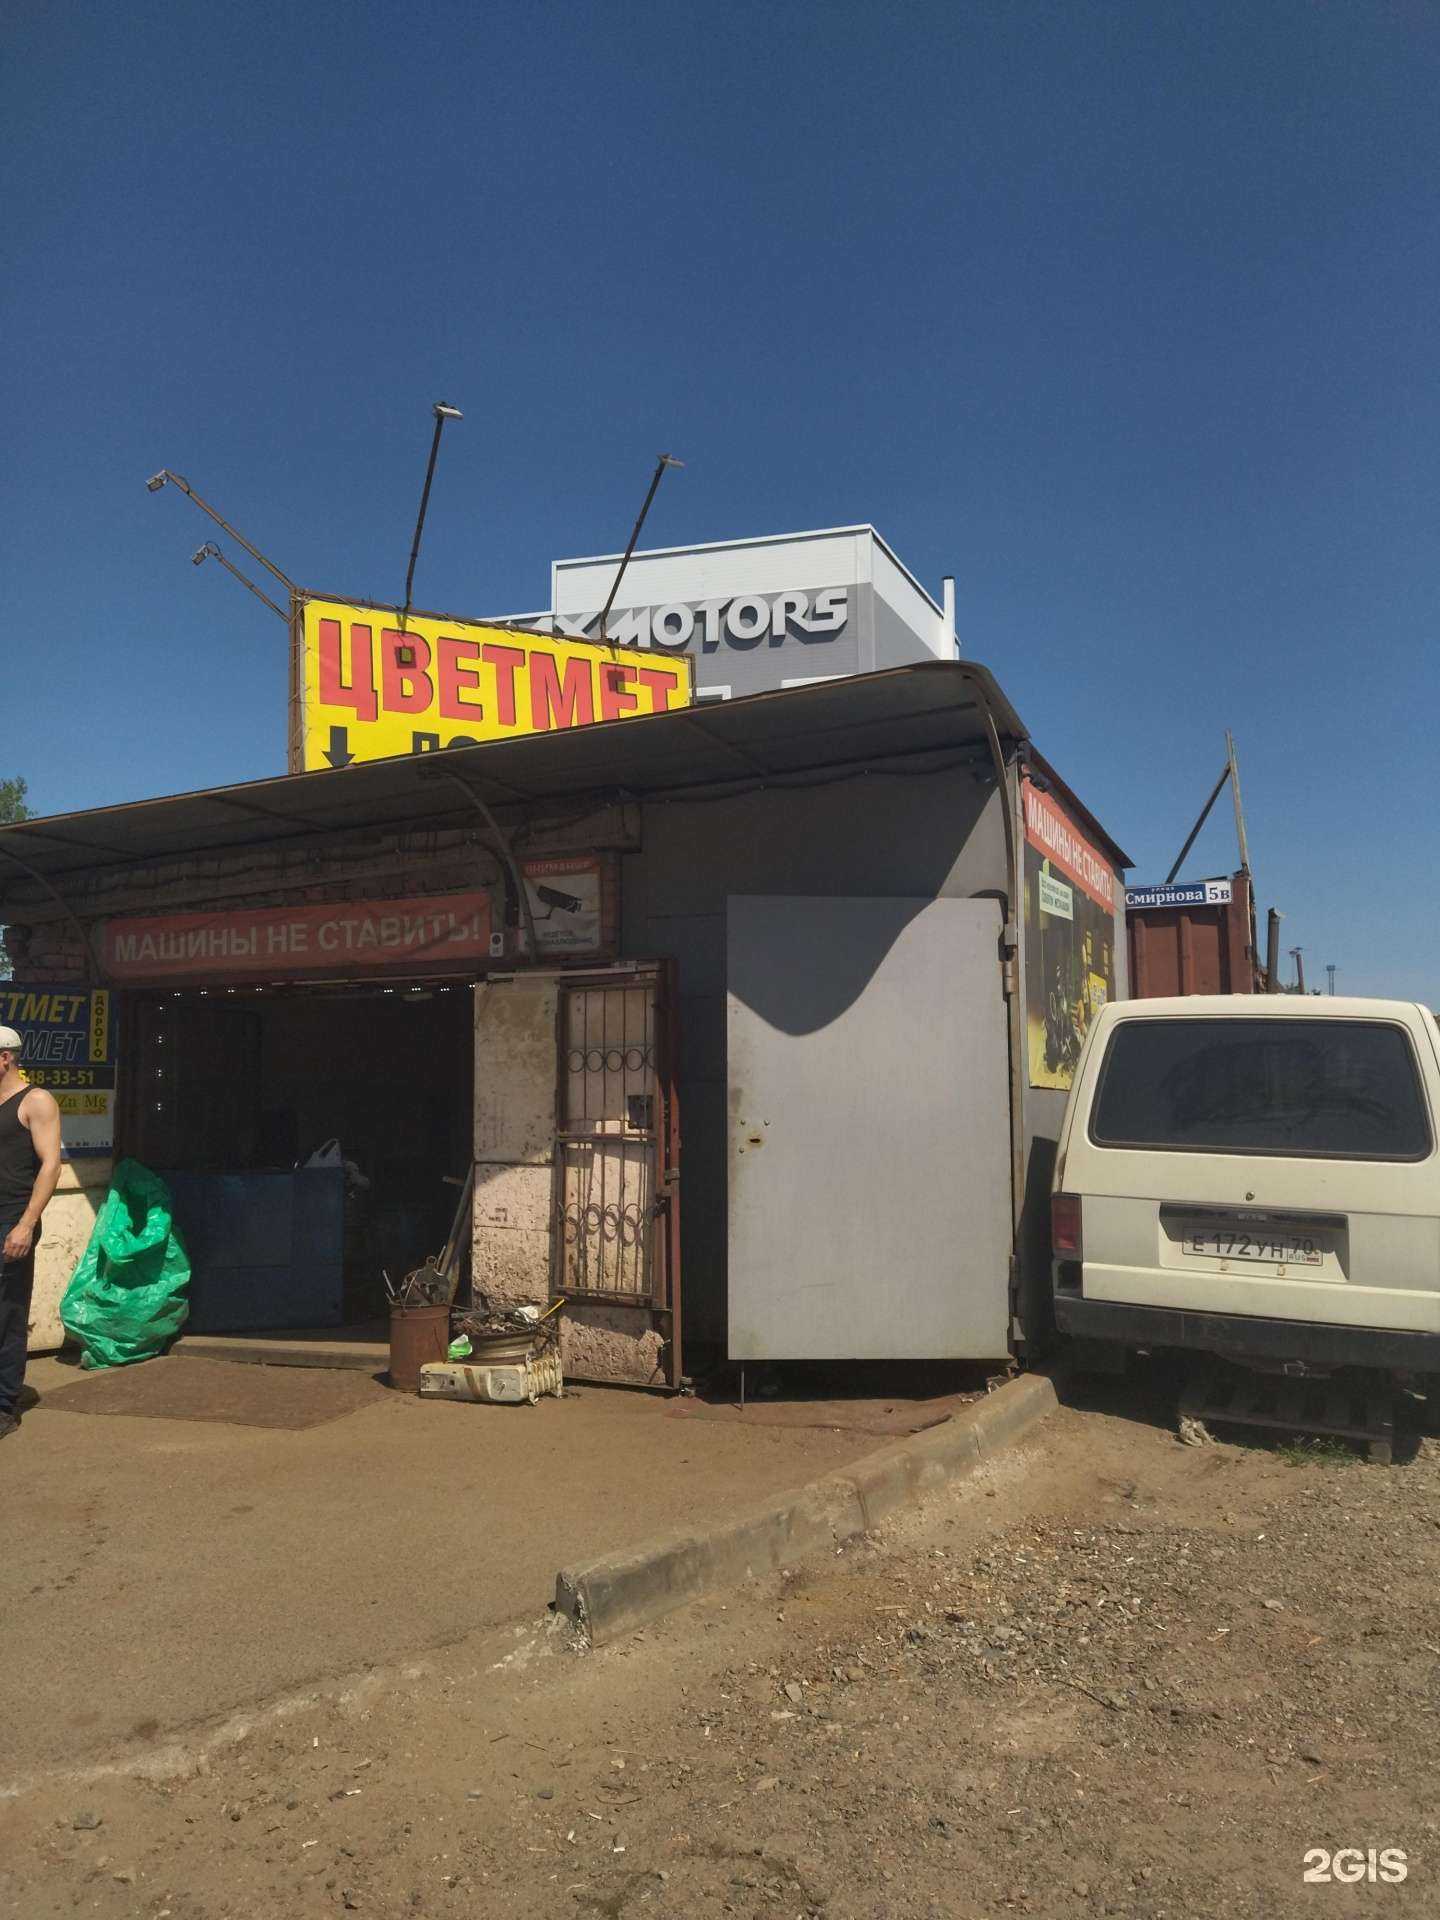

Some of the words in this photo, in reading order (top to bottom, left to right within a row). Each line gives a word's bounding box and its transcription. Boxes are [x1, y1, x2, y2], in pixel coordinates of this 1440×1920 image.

[319, 618, 678, 729] ЦВЕТМЕТ
[1027, 791, 1072, 866] МАШИНЫ
[1125, 890, 1204, 906] Смирнова
[114, 927, 257, 962] МАШИНЫ
[267, 922, 309, 953] НЕ
[317, 910, 482, 952] СТАВИТЬ!
[85, 1095, 107, 1110] Mg
